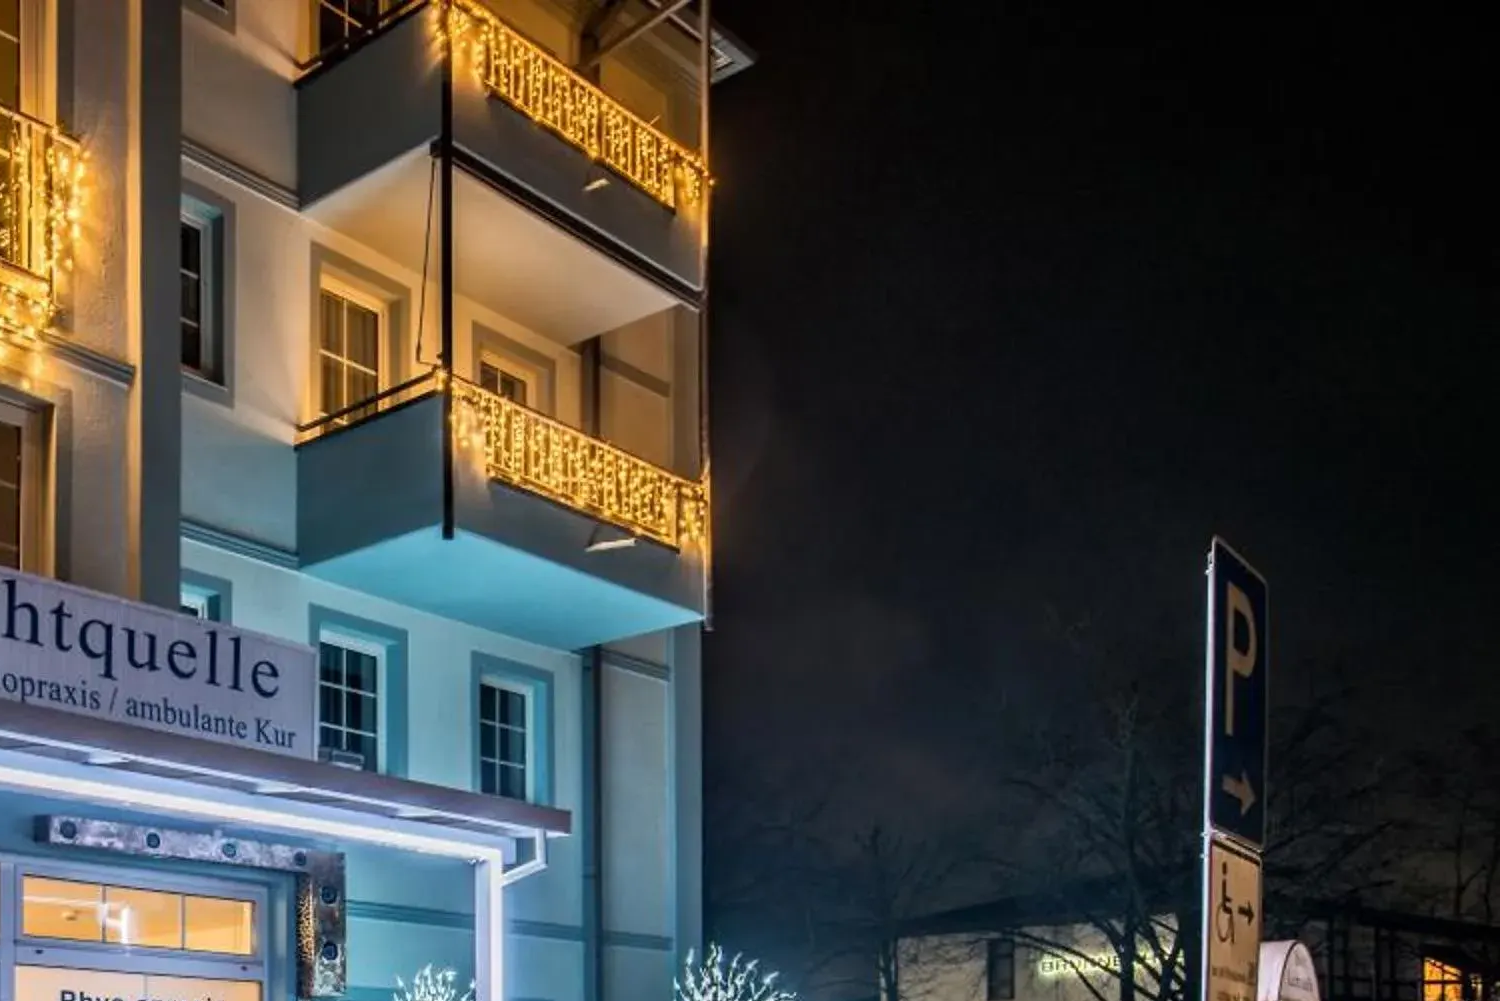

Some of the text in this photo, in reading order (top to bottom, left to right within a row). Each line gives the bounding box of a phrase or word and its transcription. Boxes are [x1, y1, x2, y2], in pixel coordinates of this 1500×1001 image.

[1225, 580, 1257, 736] P
[126, 695, 248, 739] ambulante
[254, 717, 297, 749] Kur
